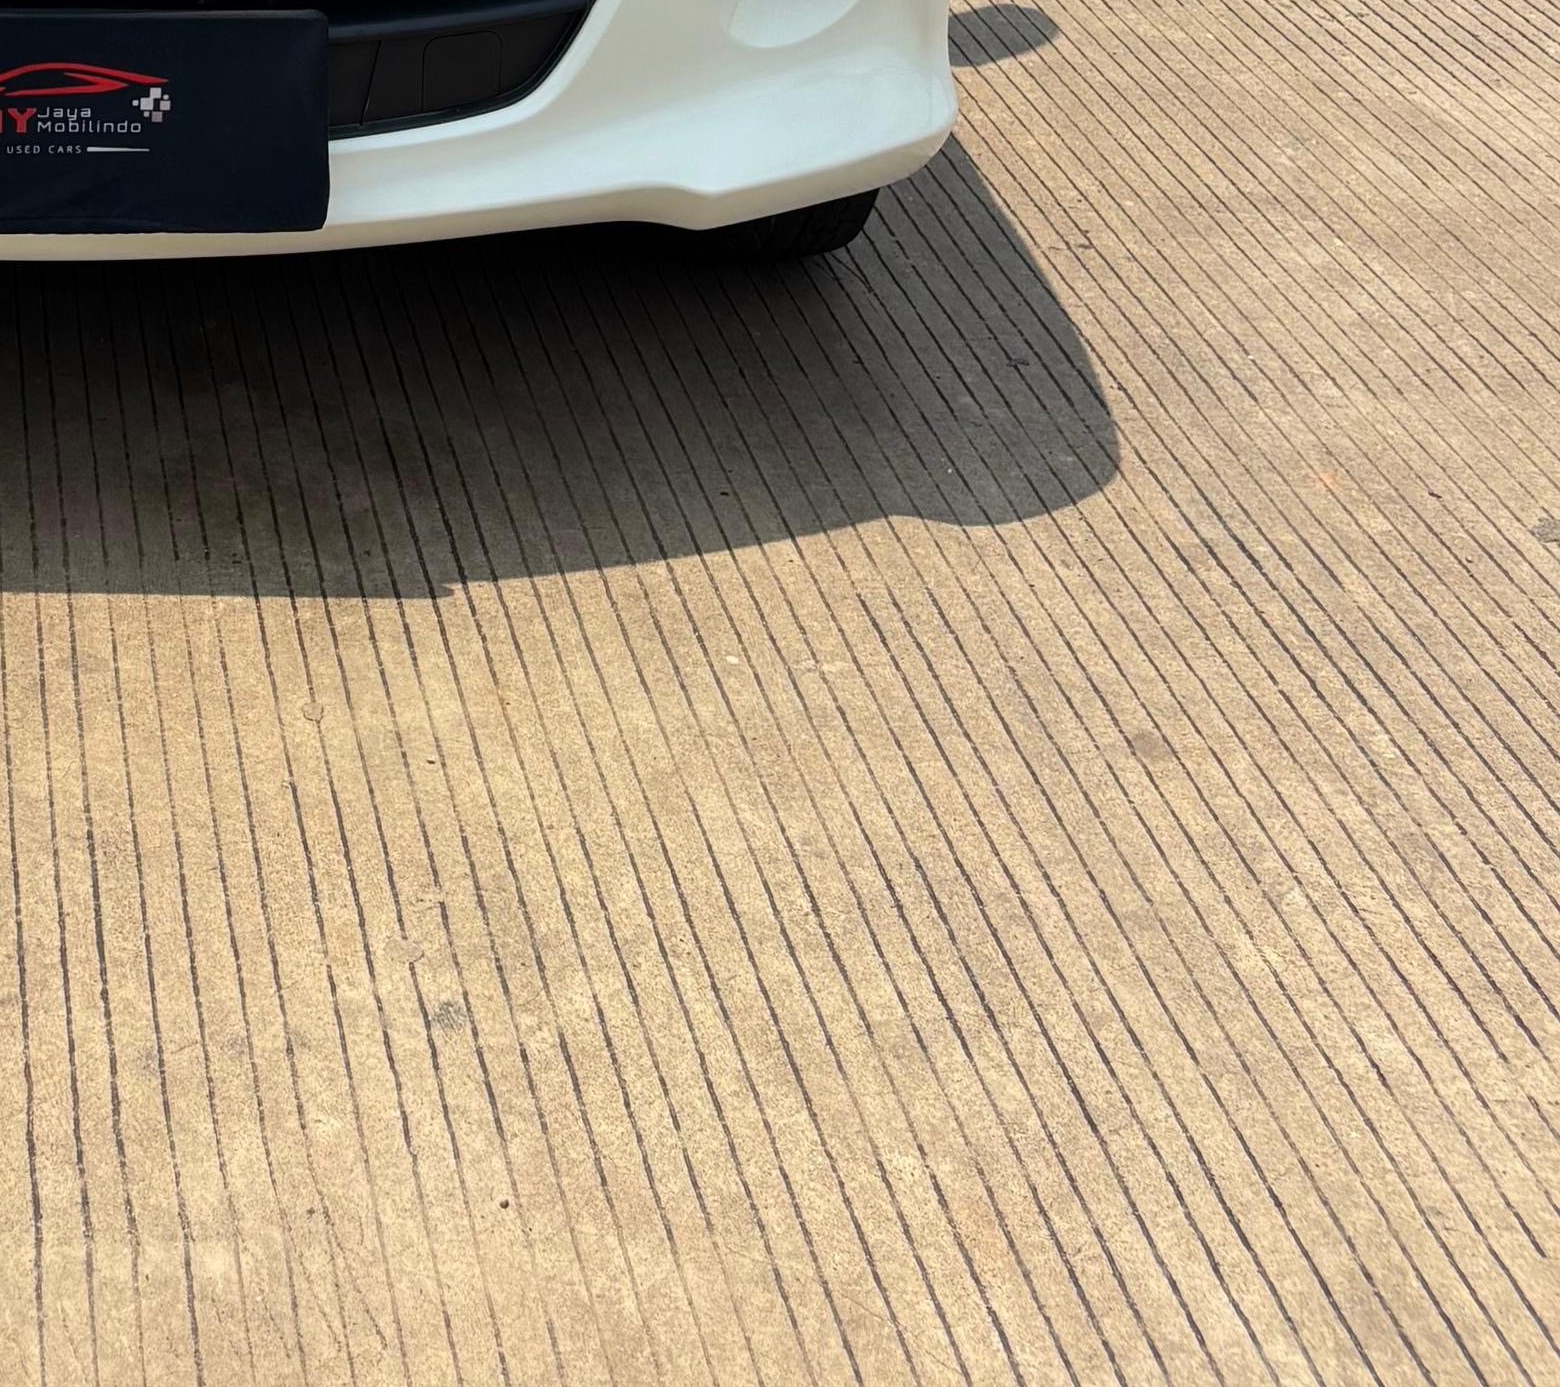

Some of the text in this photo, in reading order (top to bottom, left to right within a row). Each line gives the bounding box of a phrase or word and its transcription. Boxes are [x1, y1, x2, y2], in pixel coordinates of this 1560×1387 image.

[37, 107, 91, 122] Jaya
[37, 120, 142, 133] Mobilindo
[6, 145, 41, 154] USED
[48, 145, 82, 154] CARS
